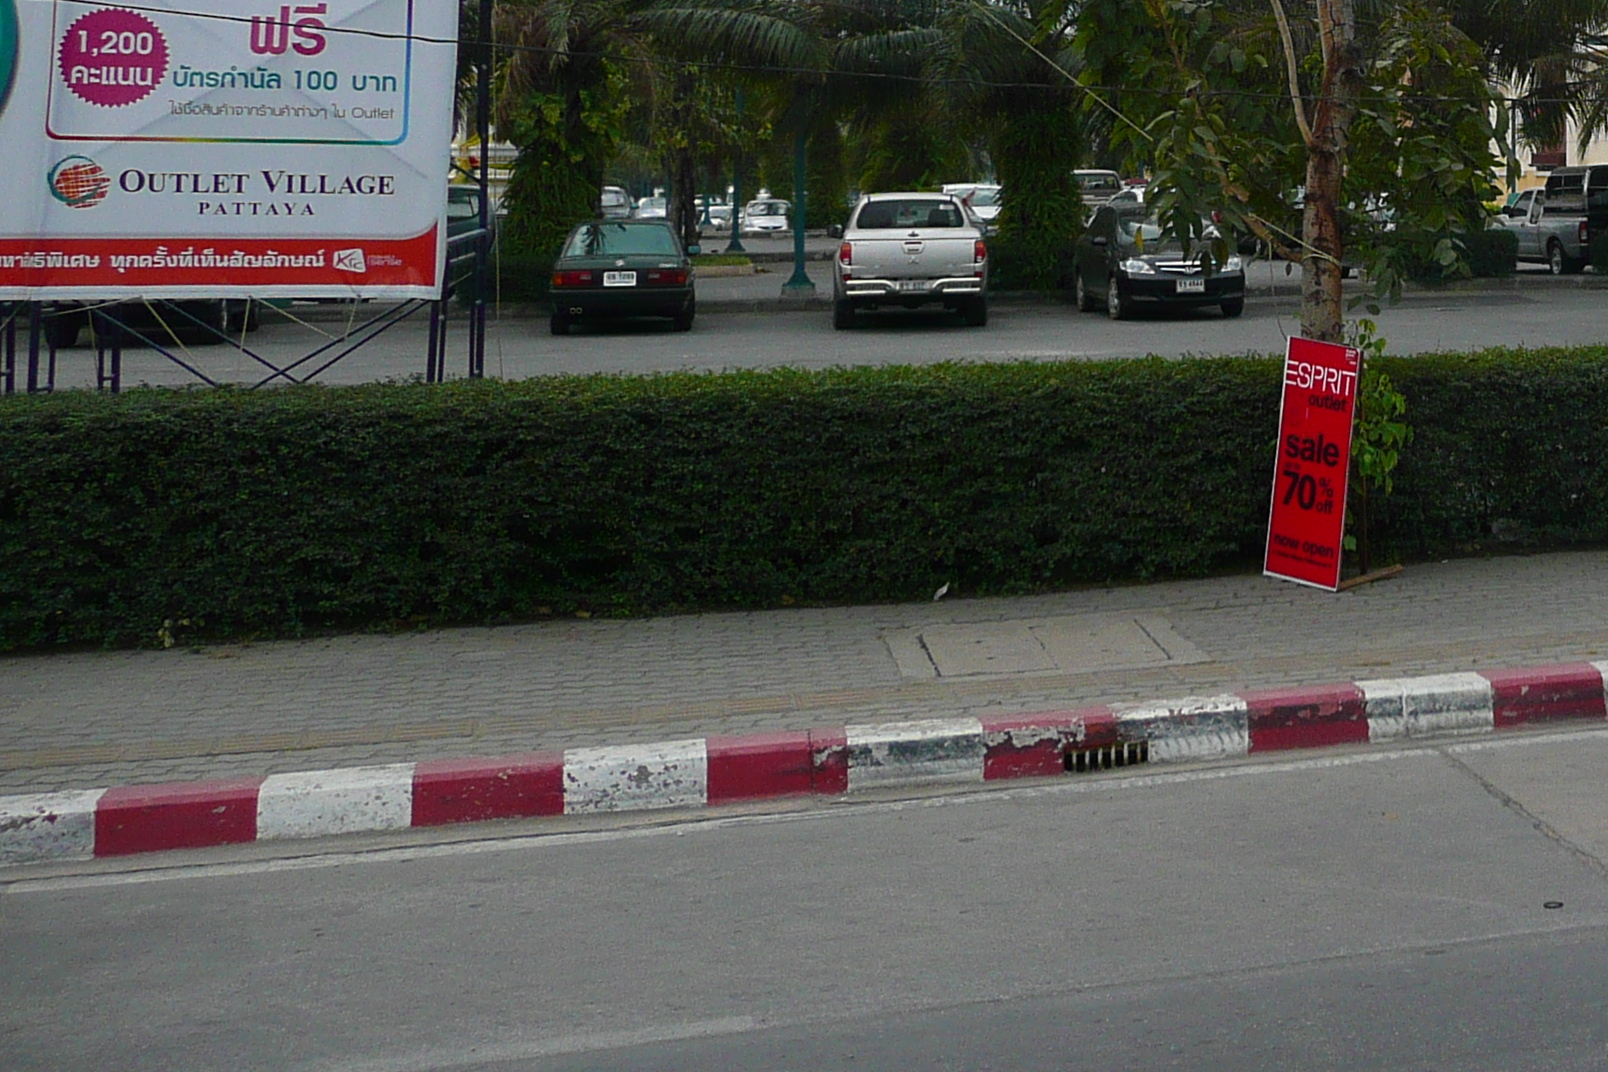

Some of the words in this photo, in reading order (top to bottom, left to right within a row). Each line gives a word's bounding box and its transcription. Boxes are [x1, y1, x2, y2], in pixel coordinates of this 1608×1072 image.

[249, 3, 327, 56] ฟรี
[77, 31, 153, 57] 1,200
[70, 65, 153, 87] คะแนน
[173, 65, 281, 89] บัตรกำนัล
[295, 70, 338, 91] 100
[352, 75, 397, 92] บาท
[332, 104, 346, 119] ใน
[352, 106, 395, 120] Outlet
[119, 169, 249, 194] OUTLET
[261, 170, 395, 196] VILLAGE
[198, 201, 316, 216] PATTAYA
[1286, 360, 1356, 396] ESPRIT
[1308, 393, 1348, 413] outlet
[1285, 433, 1340, 468] sale
[1316, 499, 1334, 515] off
[1274, 533, 1300, 550] now
[1301, 540, 1334, 558] open
